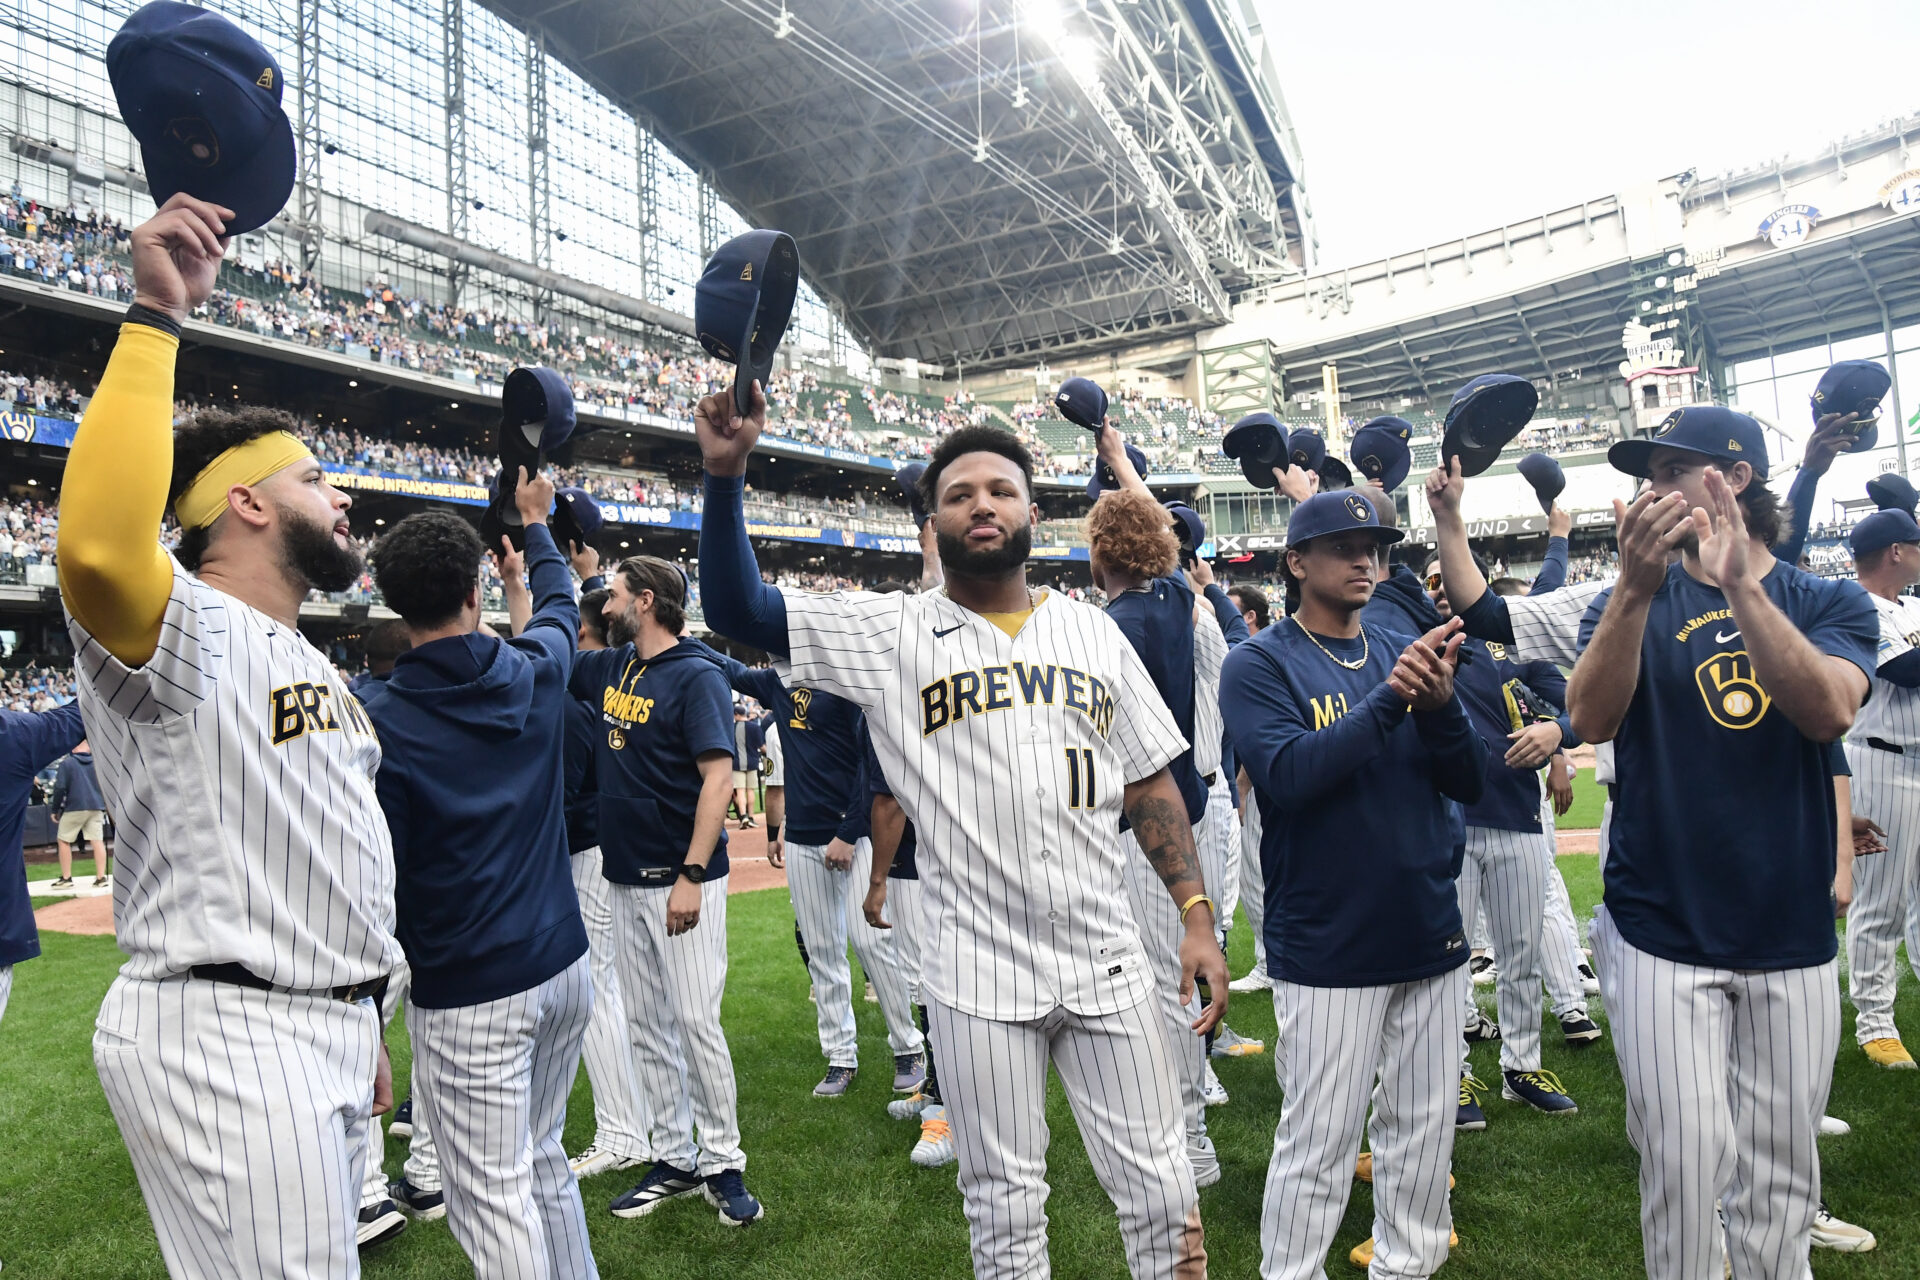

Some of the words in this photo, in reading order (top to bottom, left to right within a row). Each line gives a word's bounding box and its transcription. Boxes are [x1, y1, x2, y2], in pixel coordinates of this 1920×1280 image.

[1883, 168, 1920, 191] ROBINS
[1896, 184, 1920, 206] 42
[1767, 205, 1809, 224] FINGERS
[1776, 219, 1803, 241] 34
[1675, 300, 1688, 310] UP
[1667, 319, 1680, 329] UP
[830, 449, 855, 462] LEGENDS
[855, 453, 869, 464] CLUB
[356, 474, 384, 491] WINS
[384, 477, 396, 492] IN
[396, 478, 451, 497] FRANCHISE
[620, 506, 671, 523] WINS
[1577, 511, 1616, 525] GOL
[1467, 520, 1509, 537] UND
[878, 538, 903, 552] 103
[1217, 536, 1242, 551] X
[1675, 609, 1733, 643] MILWAUKEE
[920, 661, 1115, 739] BREWERS
[1064, 747, 1096, 809] 11
